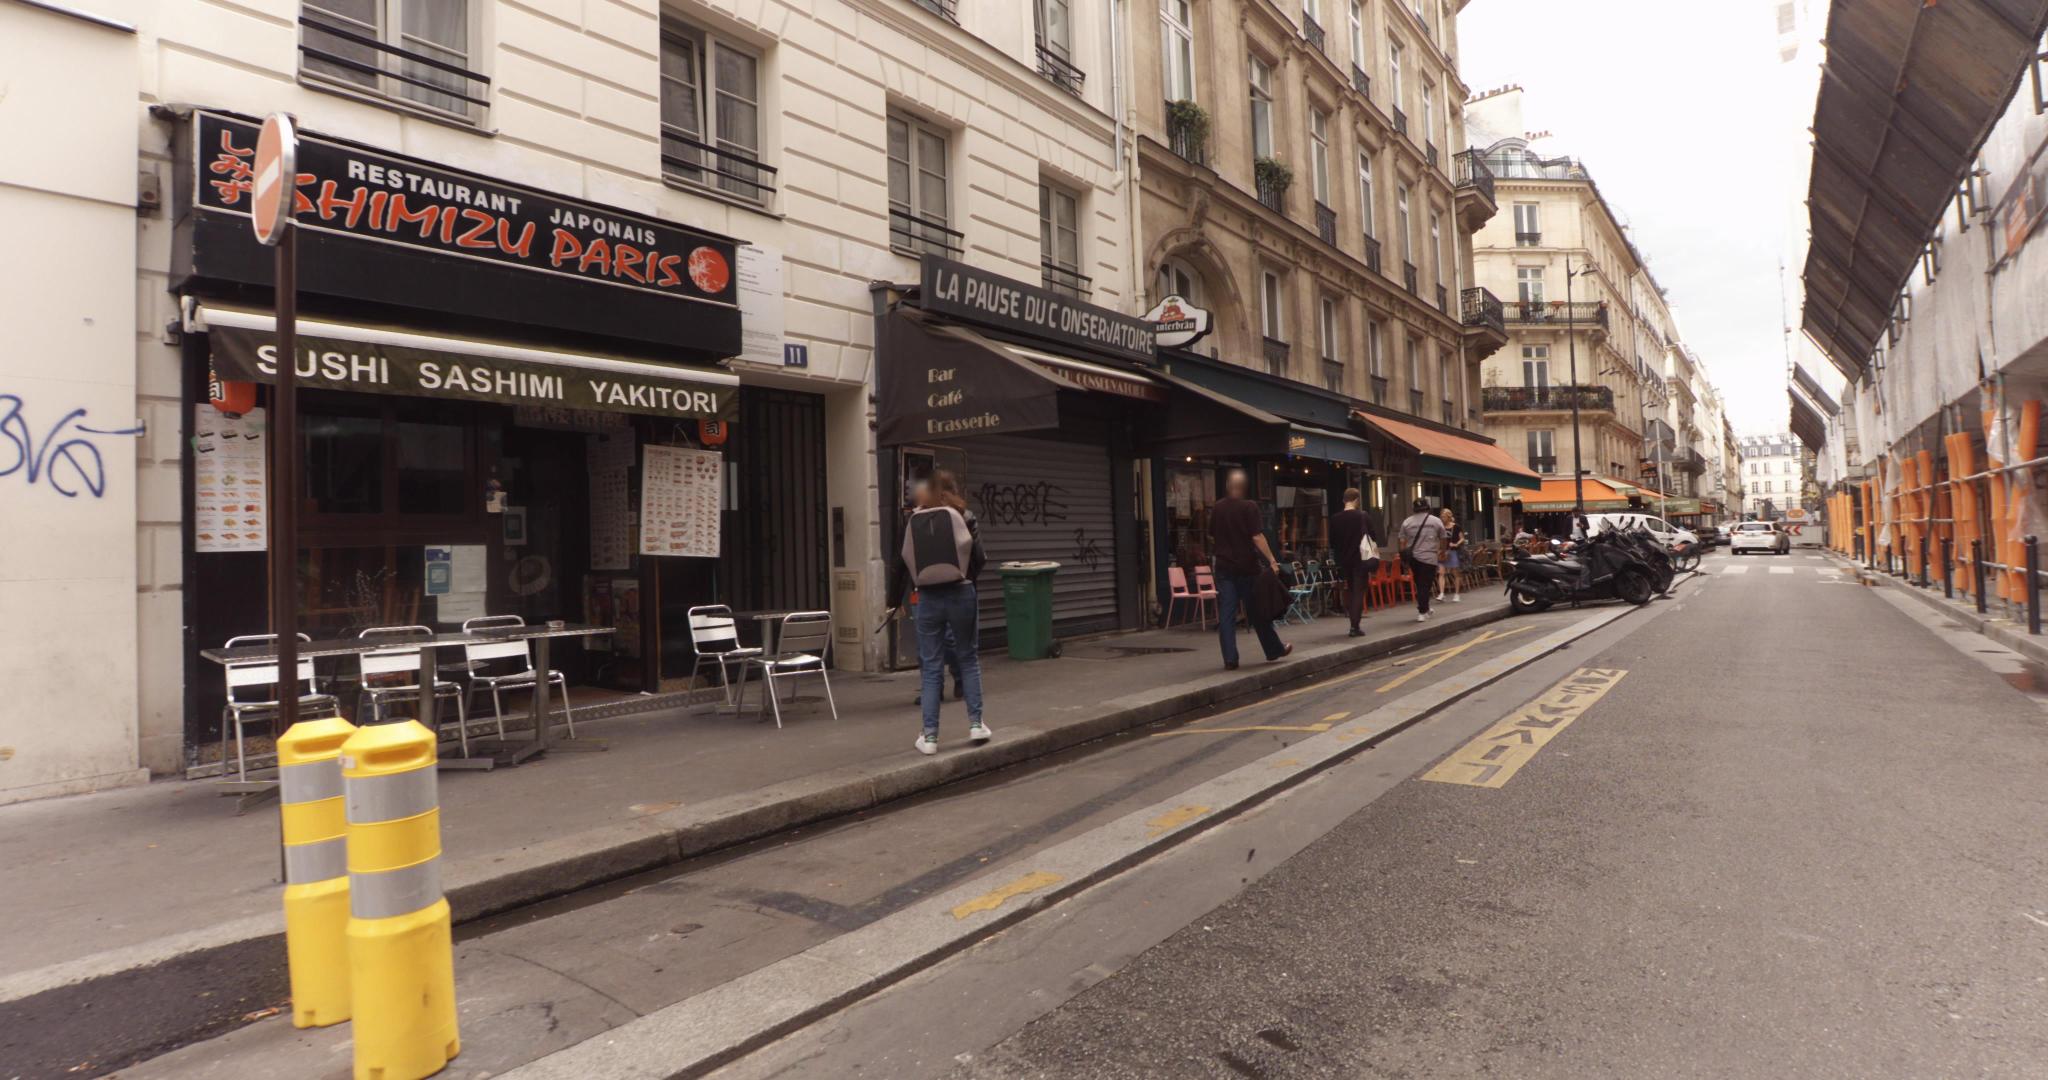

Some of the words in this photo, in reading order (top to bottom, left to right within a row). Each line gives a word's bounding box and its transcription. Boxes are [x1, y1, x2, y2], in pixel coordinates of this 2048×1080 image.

[348, 159, 523, 215] RESTAURANT
[549, 208, 656, 246] JAPONAIS
[550, 228, 682, 287] PARIS
[935, 268, 959, 302] LA
[964, 277, 1021, 319] PAUSE
[1024, 295, 1047, 325] DU
[256, 344, 389, 384] SUSHI
[418, 361, 564, 400] SASHIMI
[588, 379, 718, 413] YAKITORI
[789, 347, 801, 364] 11
[928, 367, 956, 383] Bar
[927, 388, 963, 408] Café
[927, 412, 1000, 434] Brasserie
[1459, 668, 1620, 785] LIVRAISON
